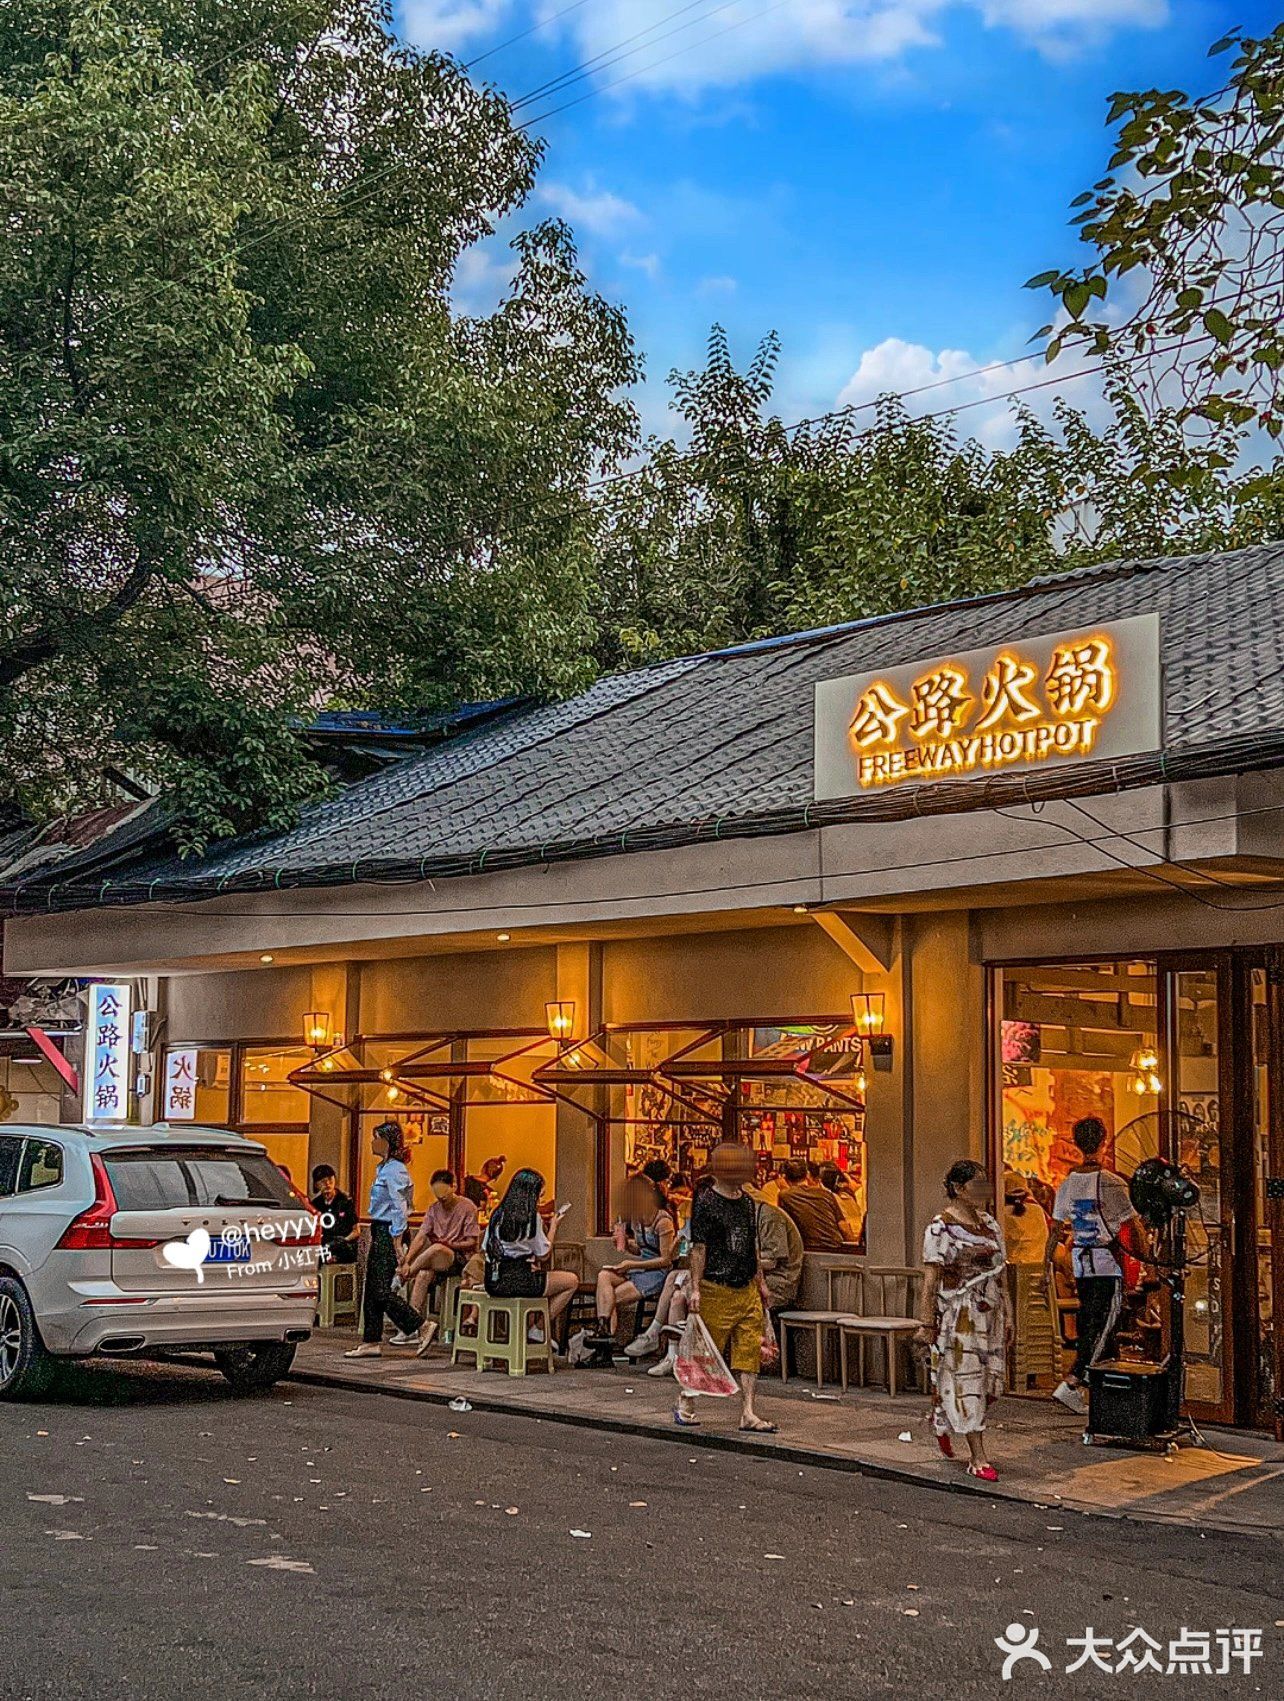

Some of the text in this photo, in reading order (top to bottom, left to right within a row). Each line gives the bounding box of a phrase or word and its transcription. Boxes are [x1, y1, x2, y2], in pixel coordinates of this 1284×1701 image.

[849, 640, 1110, 747] 公路火锅
[858, 719, 1097, 784] FREEWAYHOTPOT
[95, 993, 123, 1109] 公路火锅
